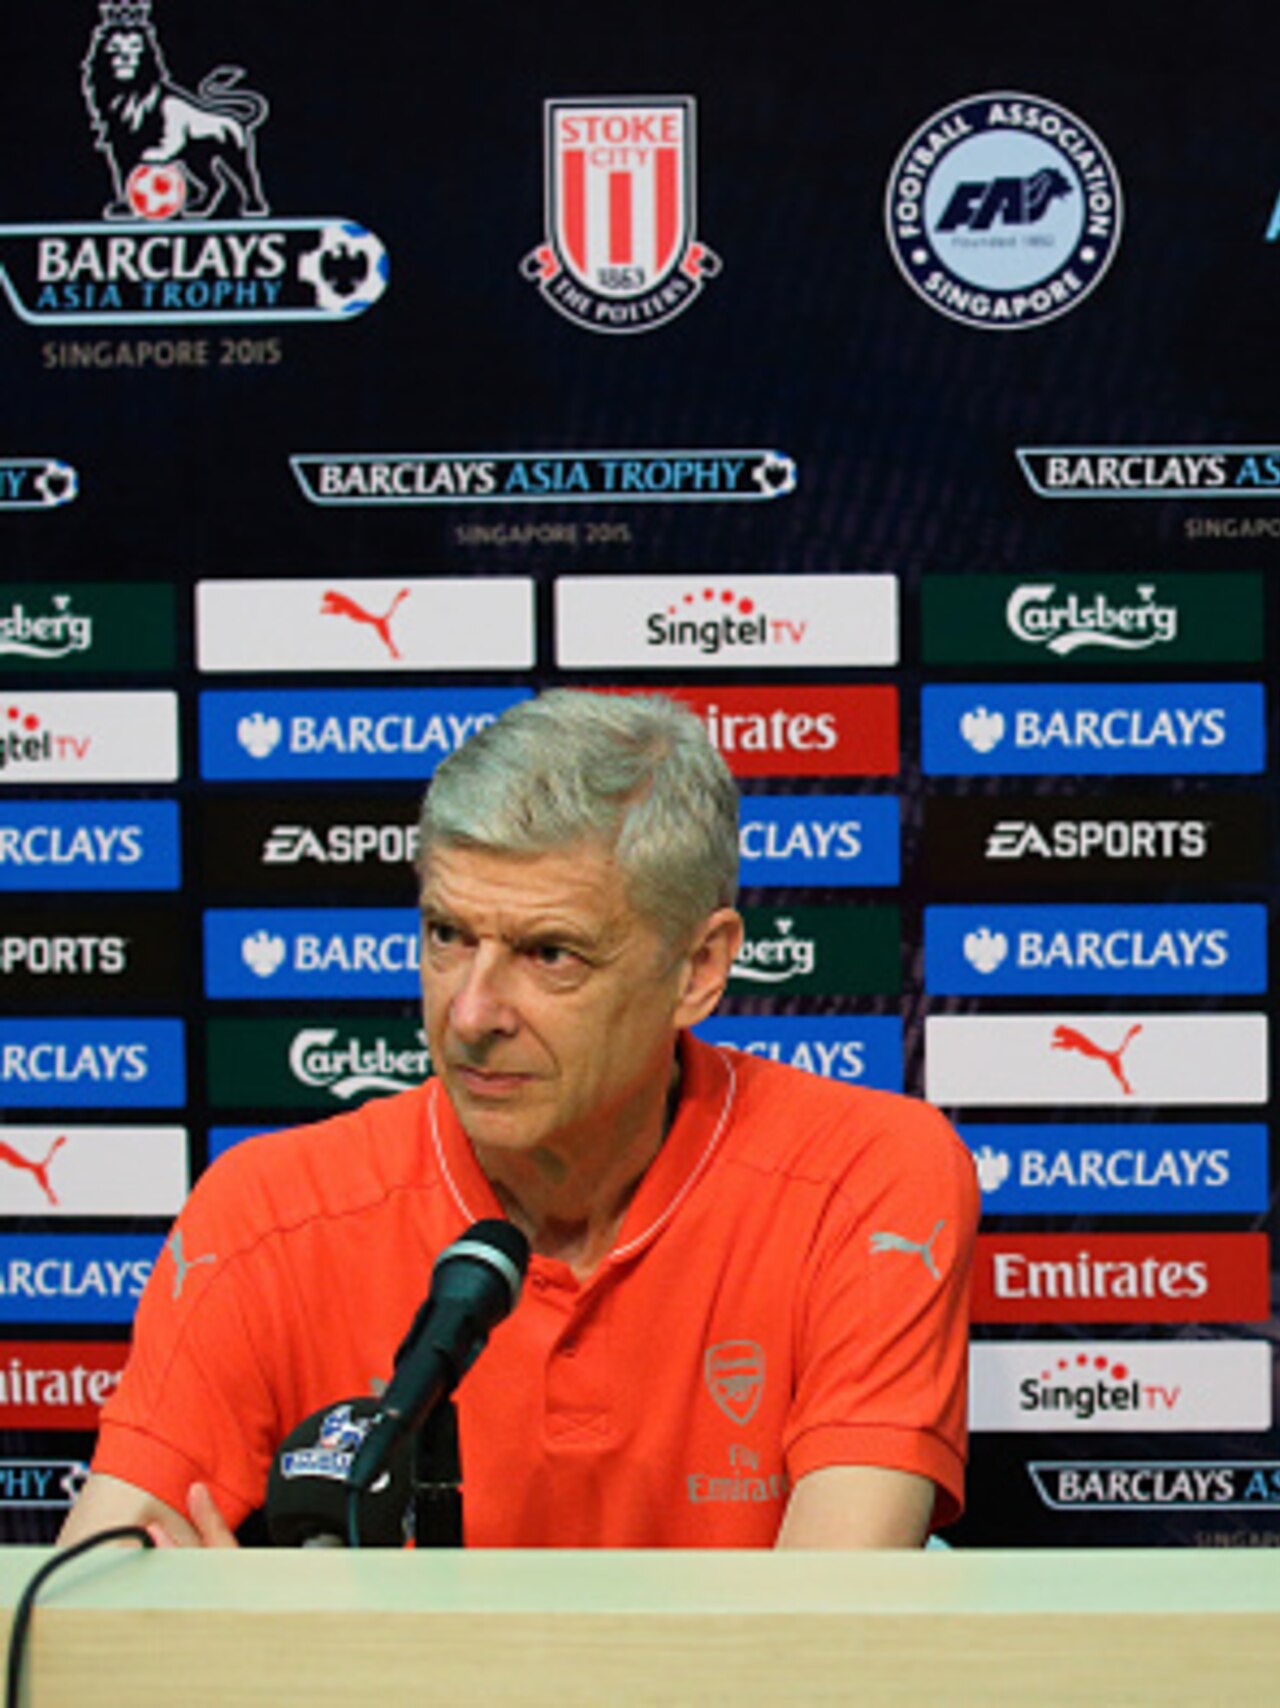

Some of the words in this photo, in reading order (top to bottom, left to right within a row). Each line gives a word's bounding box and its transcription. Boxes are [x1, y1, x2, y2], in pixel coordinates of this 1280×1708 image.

[561, 114, 680, 144] STOKE
[590, 147, 650, 168] CITY
[898, 114, 973, 238] FOOTBALL
[987, 103, 1112, 238] ASSOCIATION
[38, 233, 285, 282] BARCLAYS
[37, 284, 122, 308] ASIA
[144, 281, 277, 307] TROPHY
[924, 269, 1082, 319] SINGAPORE
[42, 339, 208, 369] SINGAPORE
[219, 338, 282, 365] 2015
[319, 464, 497, 494] BARCLAYS
[505, 463, 587, 492] ASIA
[603, 461, 743, 490] TROPHY
[1047, 454, 1226, 489] BARCLAYS
[454, 522, 578, 545] SINGAPORE
[646, 613, 767, 652] Singtel
[770, 621, 808, 645] TV
[1006, 583, 1178, 645] Carlsberg
[53, 735, 92, 760] TV
[288, 714, 492, 754] BARCLAYS
[1015, 708, 1226, 748] BARCLAYS
[262, 824, 327, 863] EA
[738, 820, 863, 859] CLAYS
[985, 822, 1052, 858] EA
[1052, 822, 1207, 858] SPORTS
[1017, 929, 1228, 969] BARCLAYS
[1019, 1149, 1229, 1187] BARCLAYS
[994, 1251, 1208, 1298] Emirates
[1019, 1375, 1139, 1419] Singtel
[1142, 1383, 1181, 1407] TV
[1057, 1470, 1235, 1503] BARCLAYS
